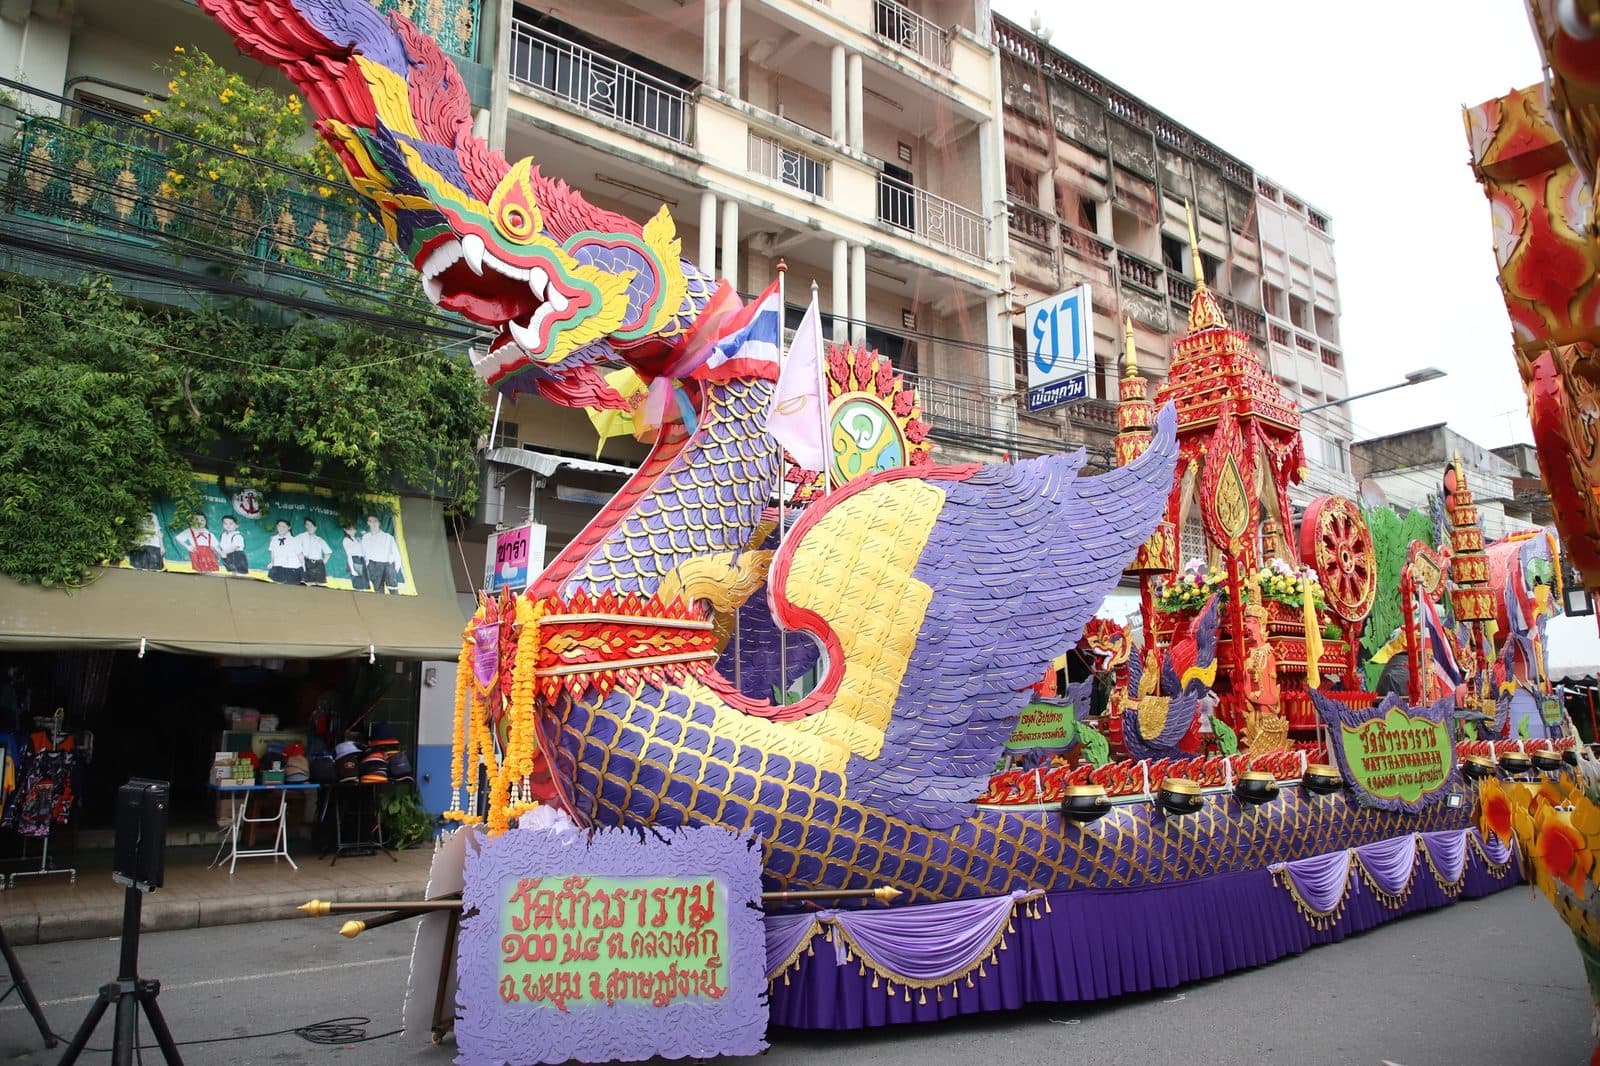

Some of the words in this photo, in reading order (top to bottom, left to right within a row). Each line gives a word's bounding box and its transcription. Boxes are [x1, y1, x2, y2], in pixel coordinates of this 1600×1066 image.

[1033, 296, 1080, 374] ยา
[1031, 380, 1083, 406] เปิดทุกวัน
[497, 532, 526, 562] ซาร่า
[509, 875, 715, 931] วัดถ้ำวราราม
[501, 933, 557, 962] ๑๐๐
